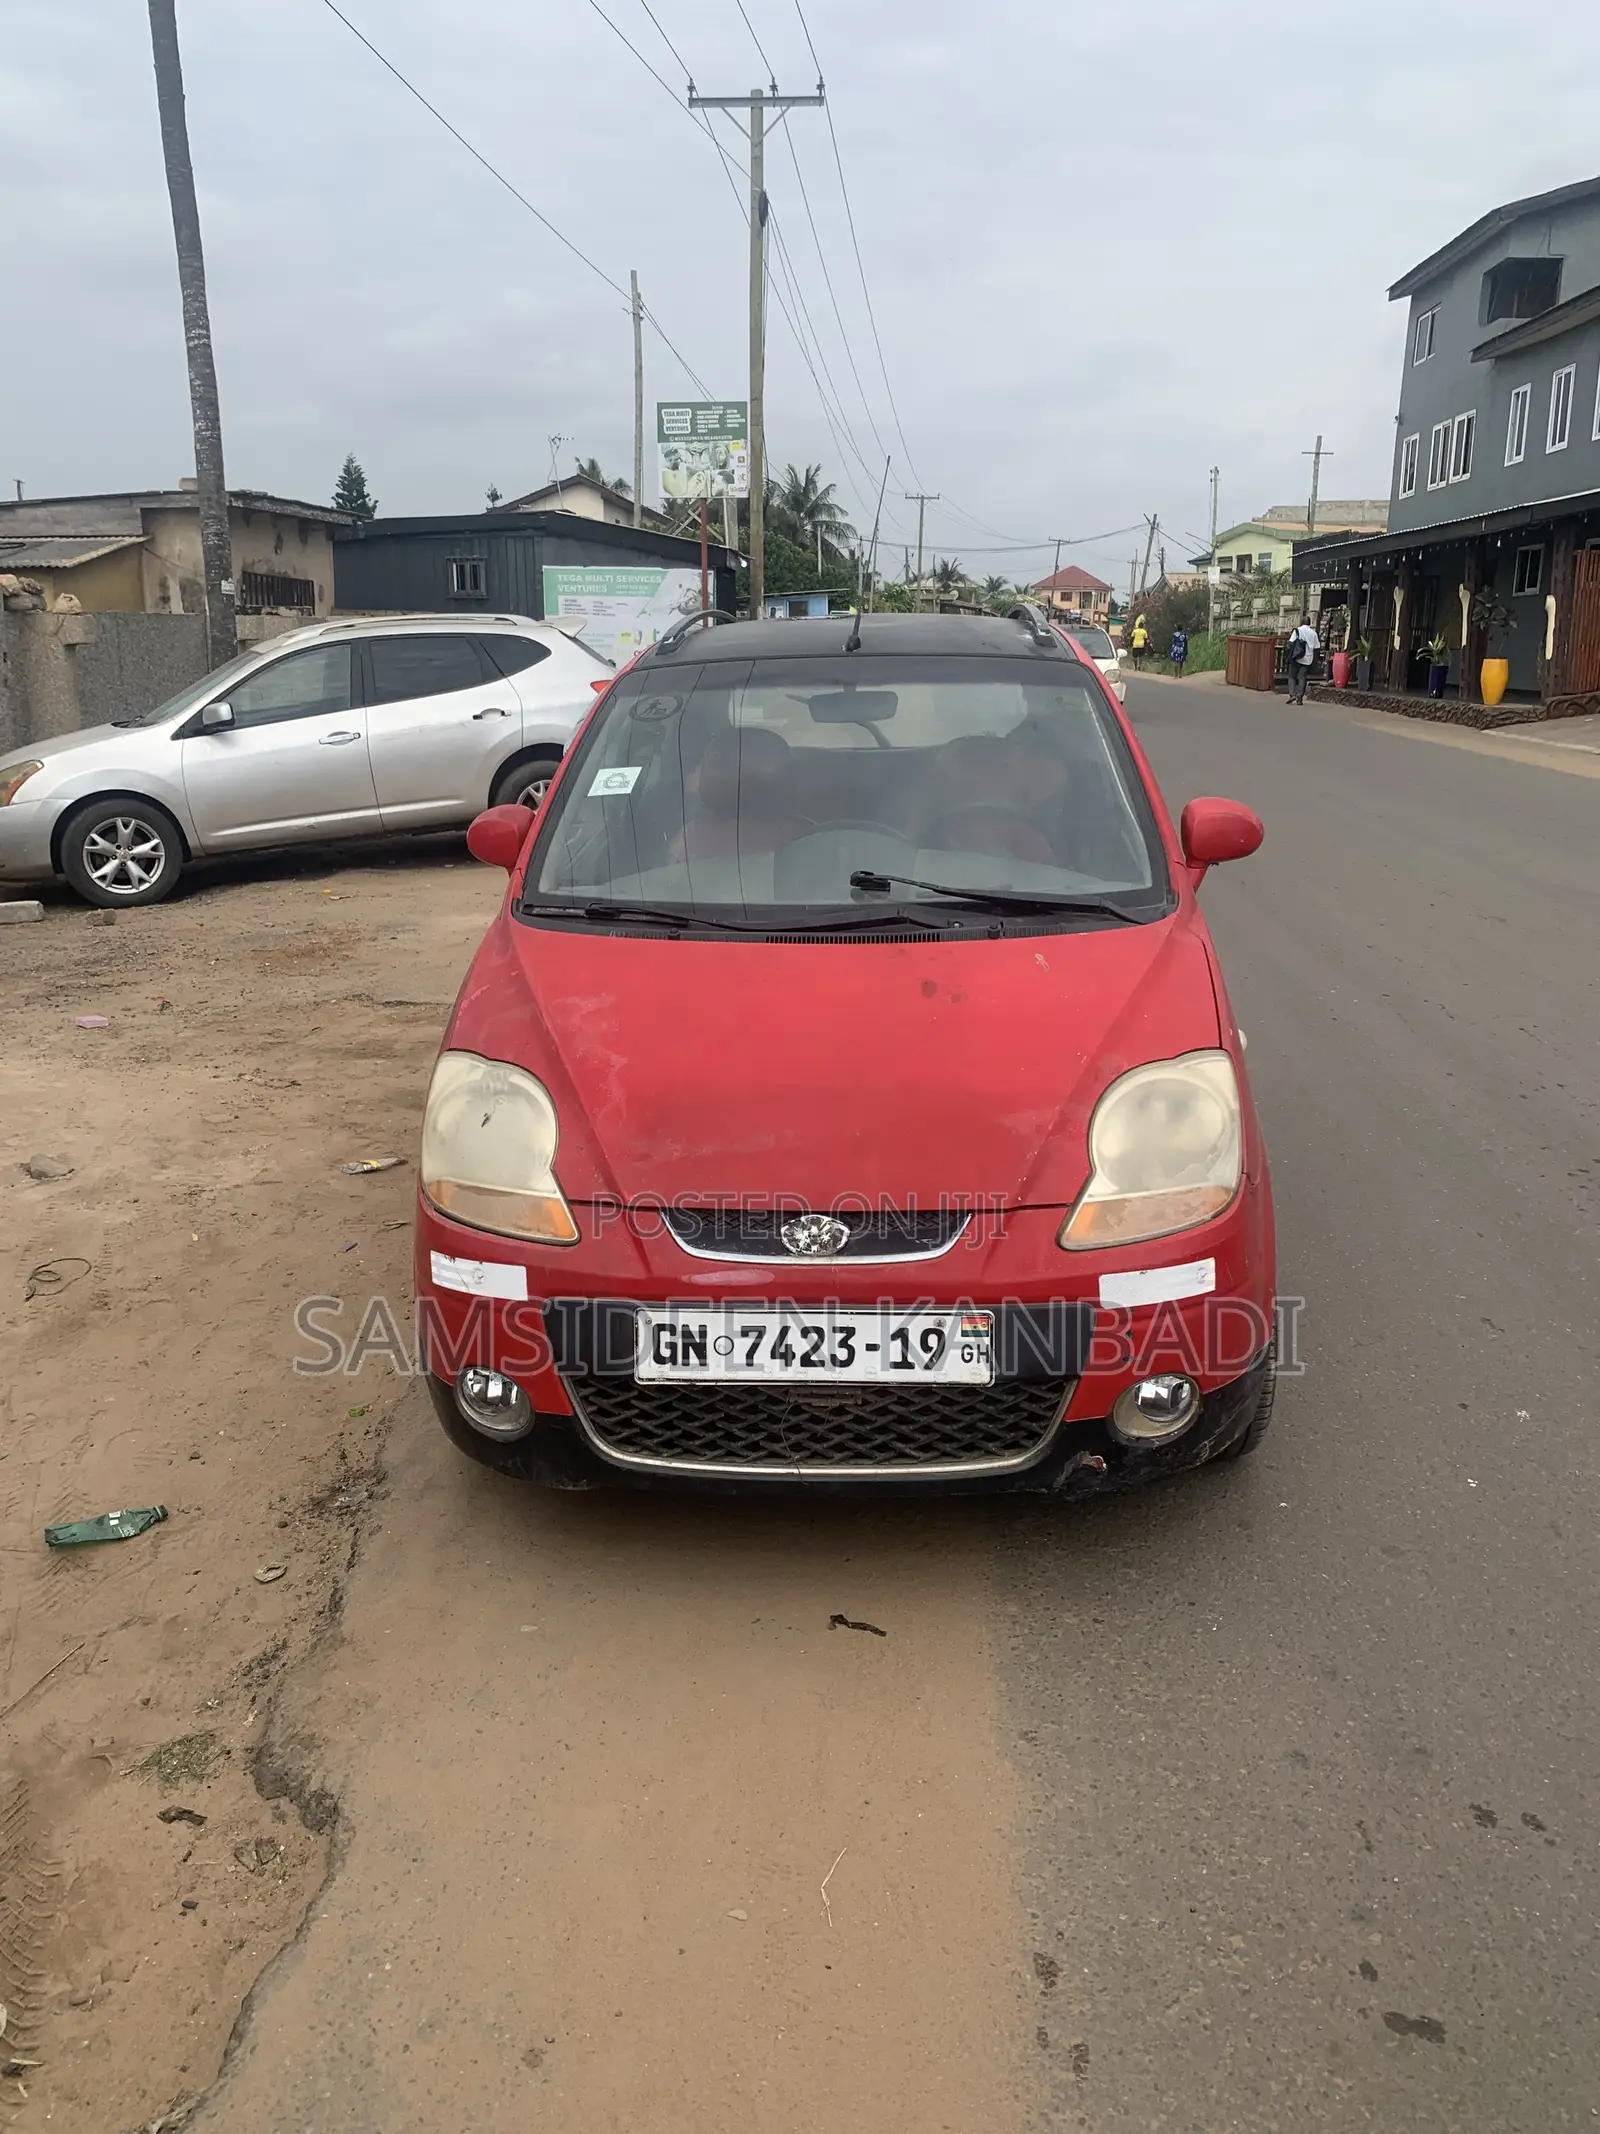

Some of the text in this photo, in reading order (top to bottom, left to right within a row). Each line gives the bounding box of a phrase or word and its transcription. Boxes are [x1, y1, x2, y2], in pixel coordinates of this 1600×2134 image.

[557, 574, 662, 584] TEGA MULTI SERVICES
[557, 584, 608, 593] VENTURES
[652, 1322, 946, 1370] GN 7423-19
[960, 1343, 990, 1364] GH
